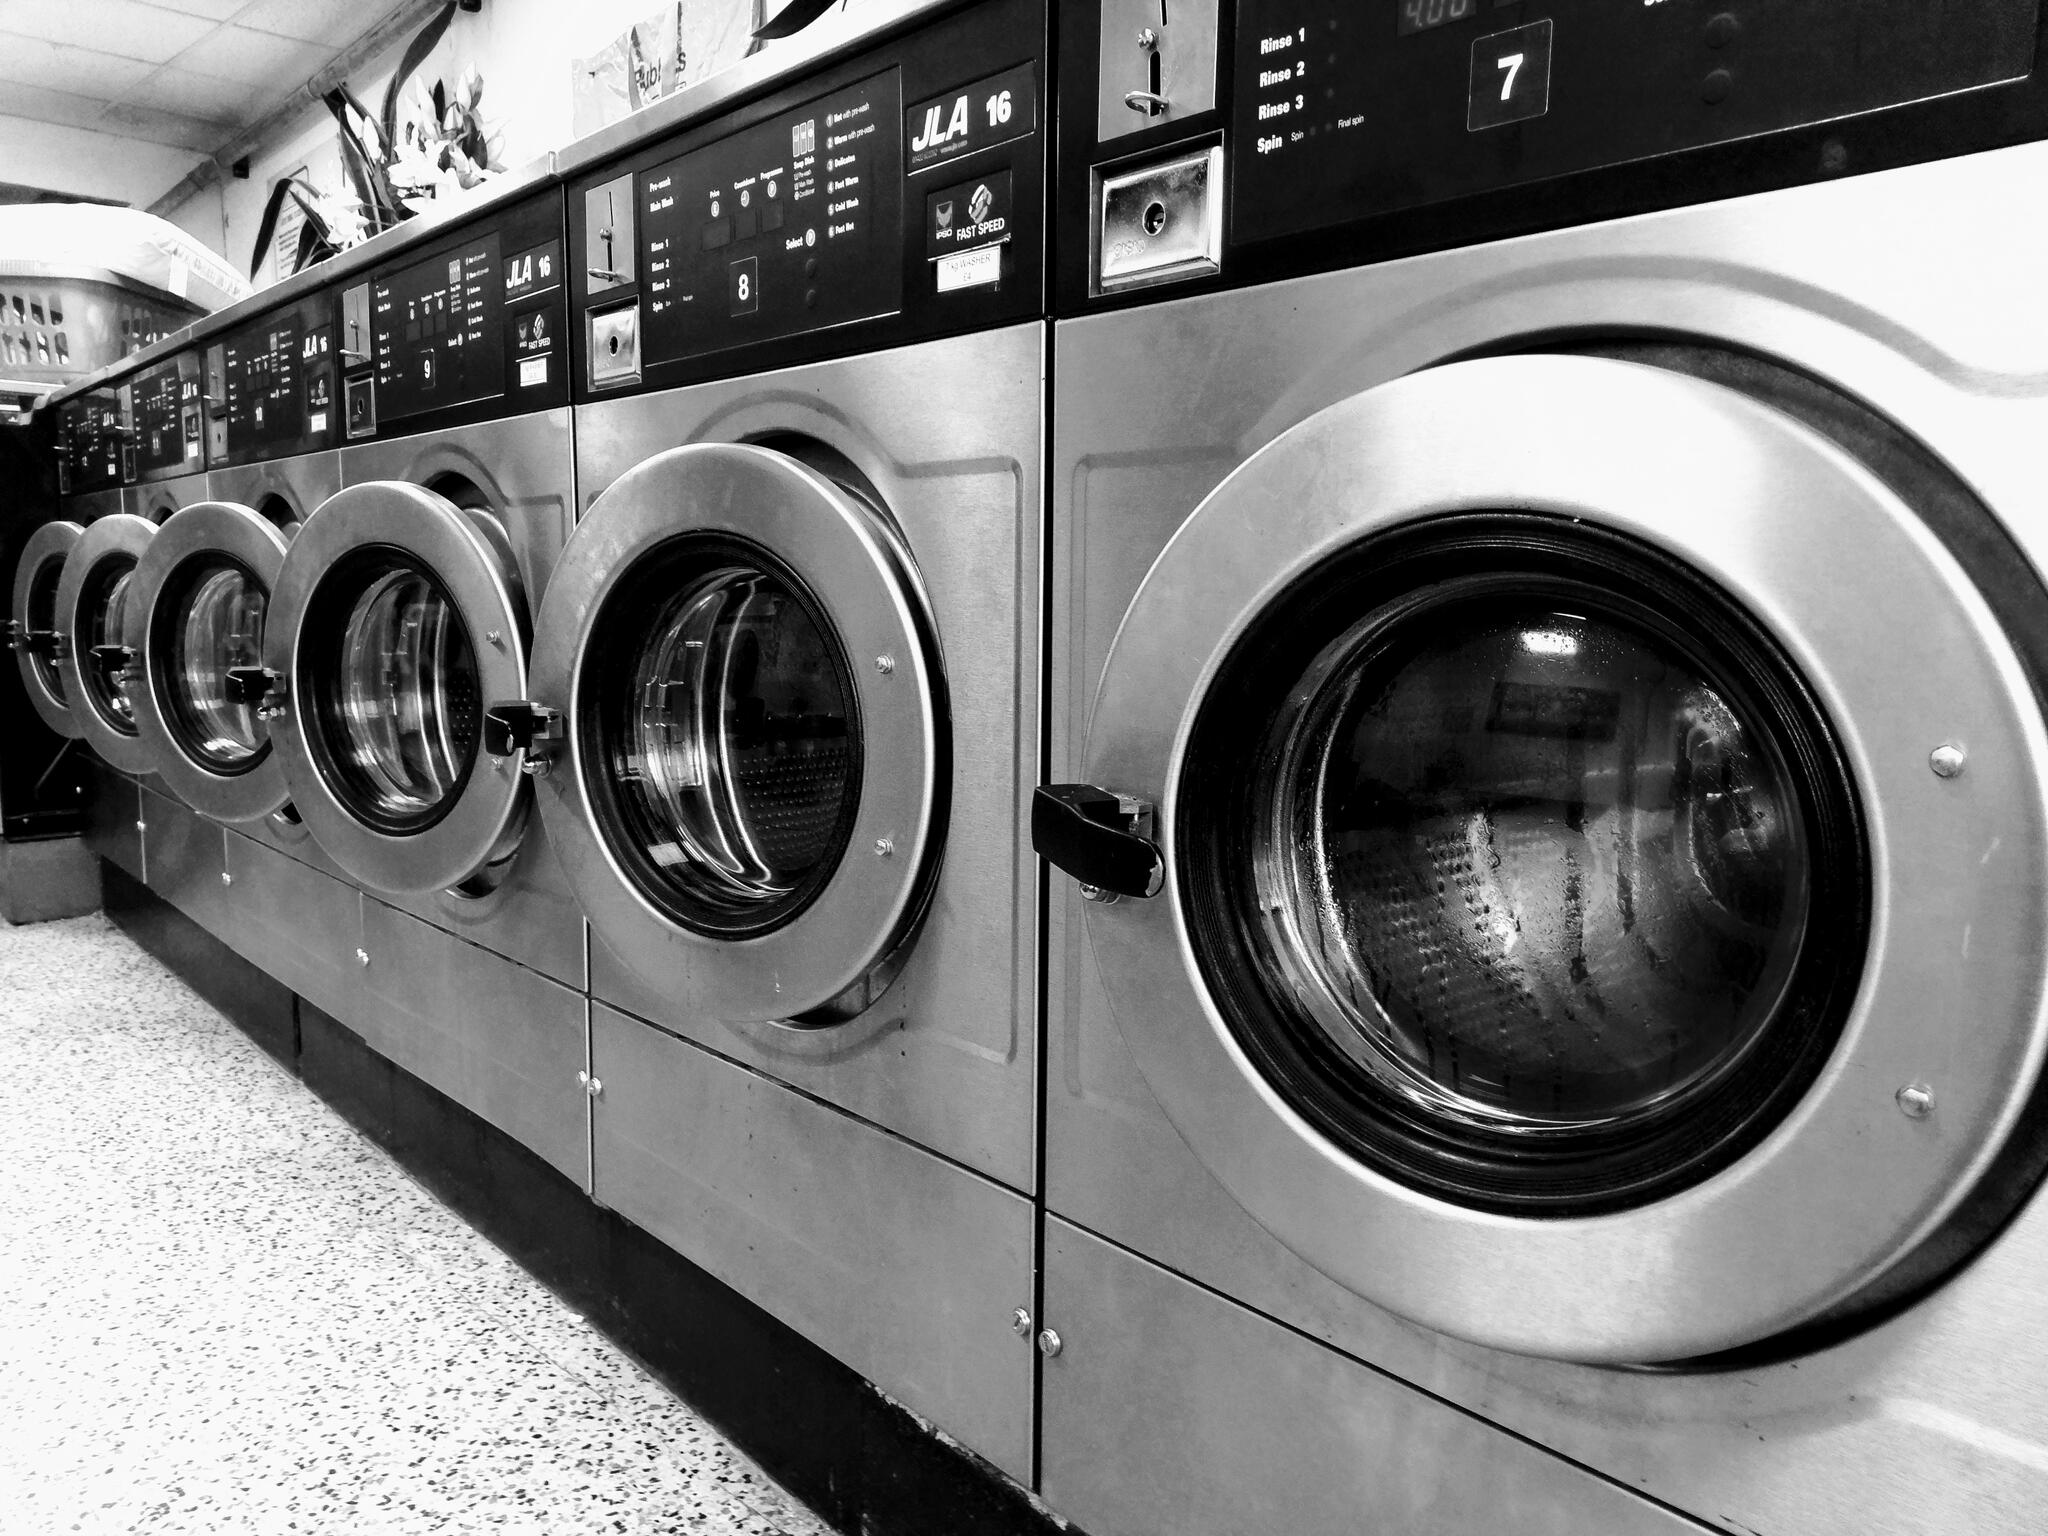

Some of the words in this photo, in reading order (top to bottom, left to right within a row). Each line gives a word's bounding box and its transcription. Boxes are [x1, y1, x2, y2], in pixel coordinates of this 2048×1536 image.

[1261, 35, 1292, 54] Rinse
[1299, 28, 1304, 42] 1
[1260, 69, 1291, 87] Rinse
[1297, 61, 1305, 76] 2
[1498, 53, 1523, 100] 7
[1259, 102, 1290, 120] Rinse
[1295, 95, 1303, 109] 3
[912, 95, 968, 152] JLA
[986, 91, 1011, 126] 16
[1257, 135, 1282, 154] Spin
[1291, 131, 1303, 141] Spin
[1338, 118, 1351, 128] Final
[1352, 114, 1365, 127] spin
[956, 225, 977, 242] FAST
[978, 217, 1005, 236] SPEED
[785, 236, 803, 250] Select
[506, 255, 532, 289] JLA
[539, 255, 550, 277] 16
[960, 253, 991, 268] WASHER
[739, 274, 749, 300] 8
[303, 335, 317, 358] JLA
[424, 360, 430, 378] 9
